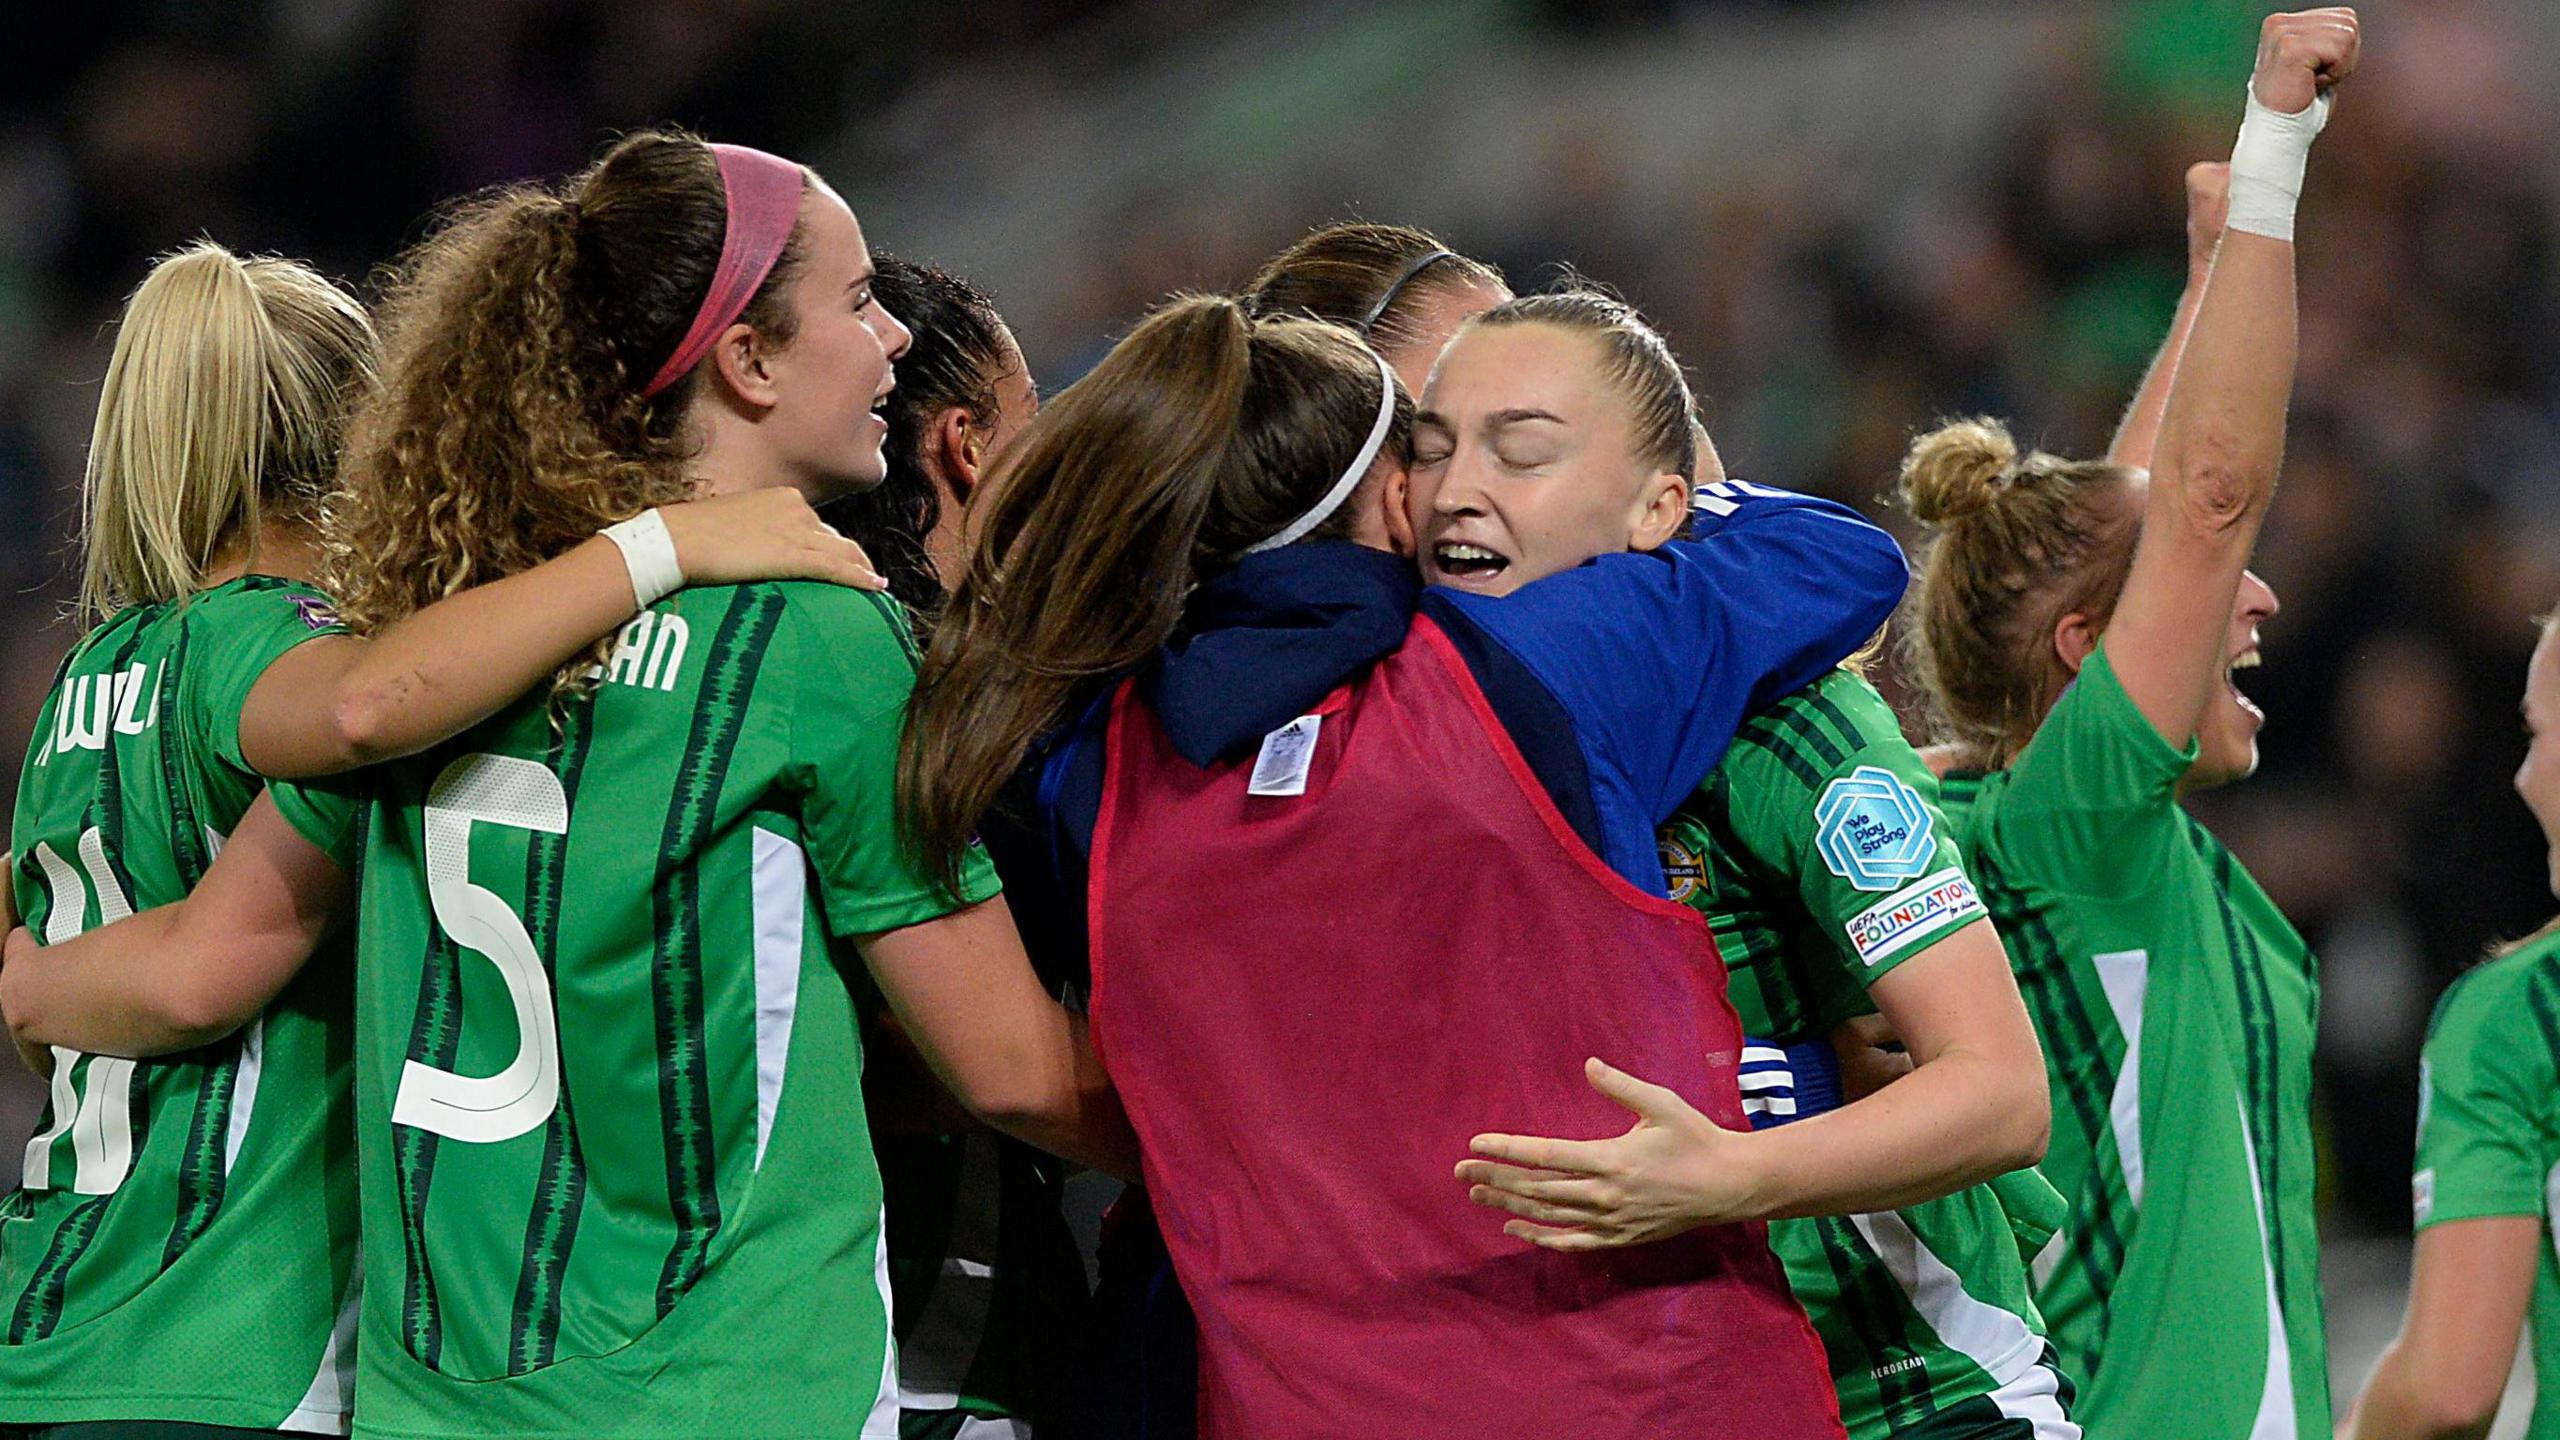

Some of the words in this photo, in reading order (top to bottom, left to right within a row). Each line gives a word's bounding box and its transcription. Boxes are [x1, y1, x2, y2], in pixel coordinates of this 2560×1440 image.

[586, 610, 690, 692] AN
[1846, 814, 1870, 829] We
[1854, 822, 1886, 843] Play
[1861, 827, 1907, 854] Strong
[1849, 912, 1878, 935] UEFA
[1855, 881, 1972, 951] FOUNDATION
[391, 752, 569, 1144] 5
[22, 825, 138, 1195] 11
[1870, 1356, 1927, 1381] AEROREADY
